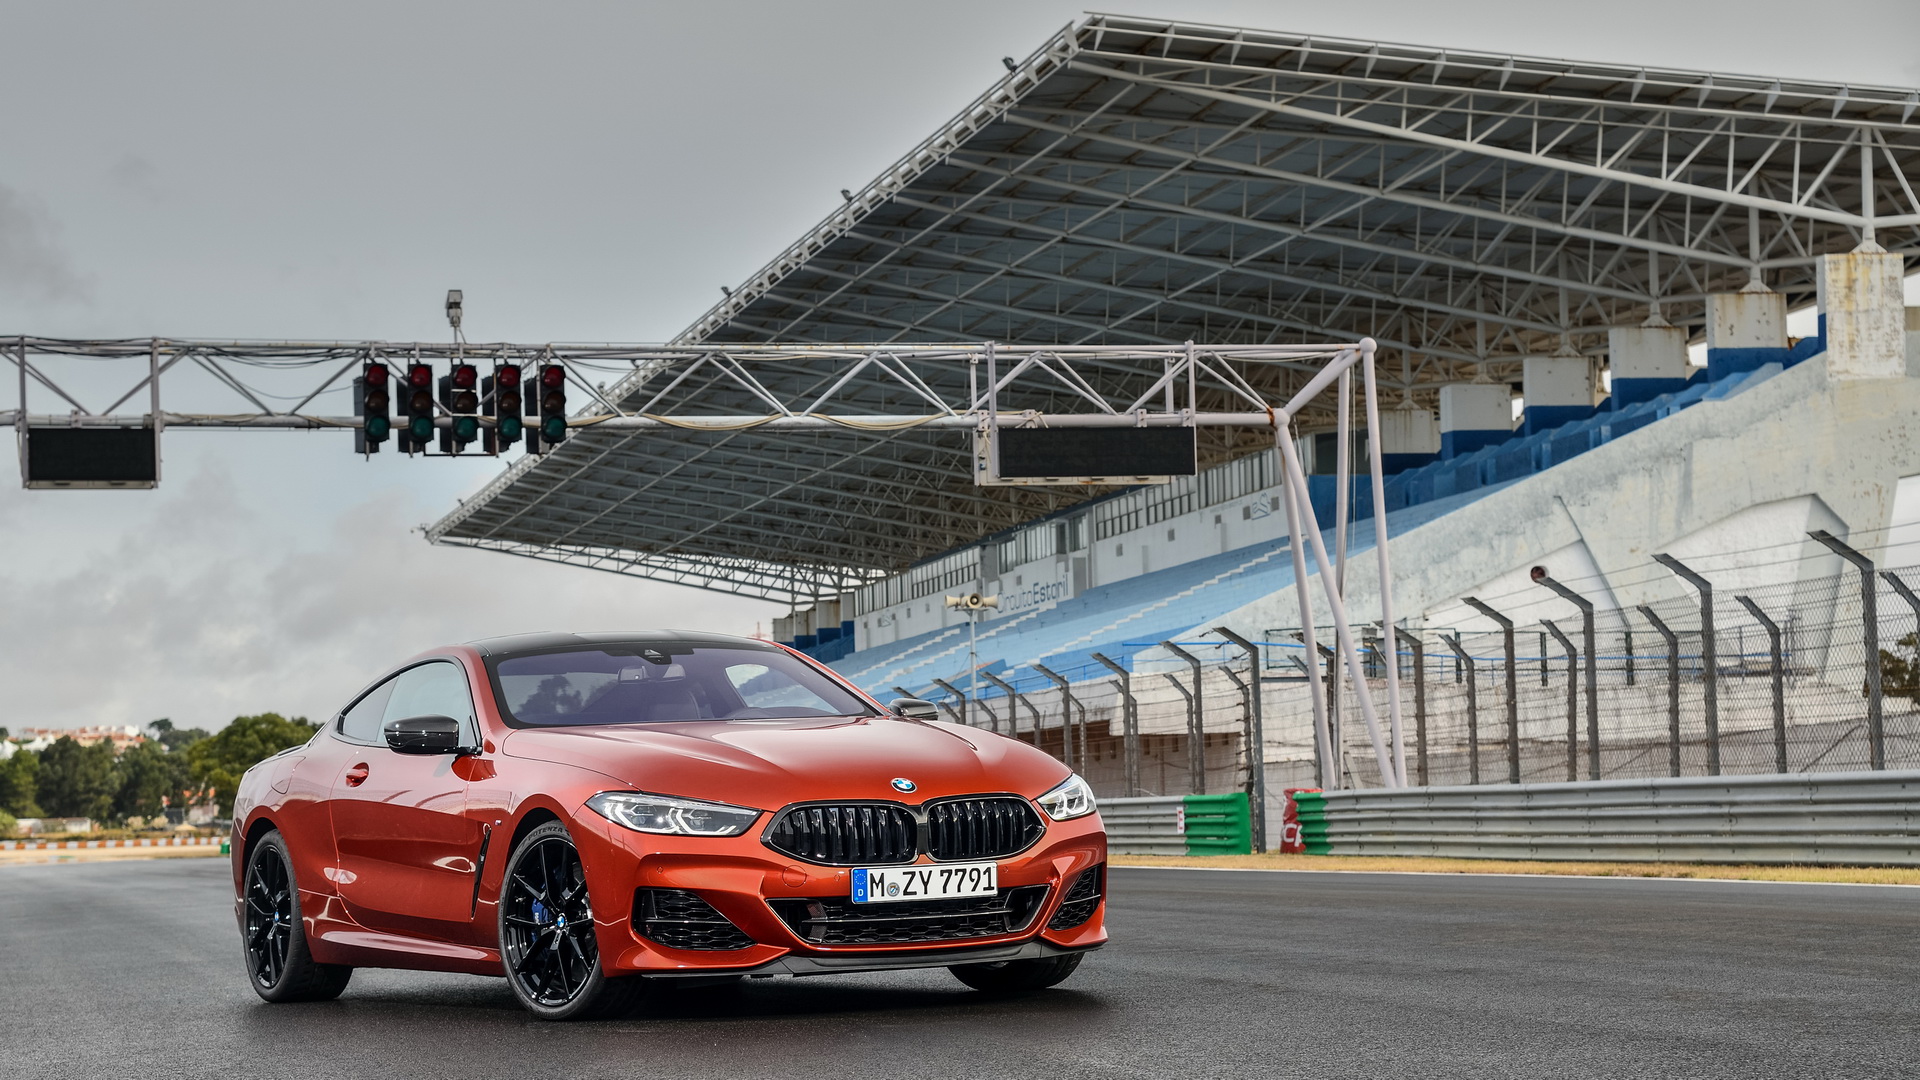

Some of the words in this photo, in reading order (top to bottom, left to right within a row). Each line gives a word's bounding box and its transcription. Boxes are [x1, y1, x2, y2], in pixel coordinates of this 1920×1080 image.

[527, 826, 563, 841] POTENZA
[869, 872, 885, 898] M
[902, 870, 933, 896] ZY
[939, 866, 995, 894] 7791
[857, 888, 864, 897] D
